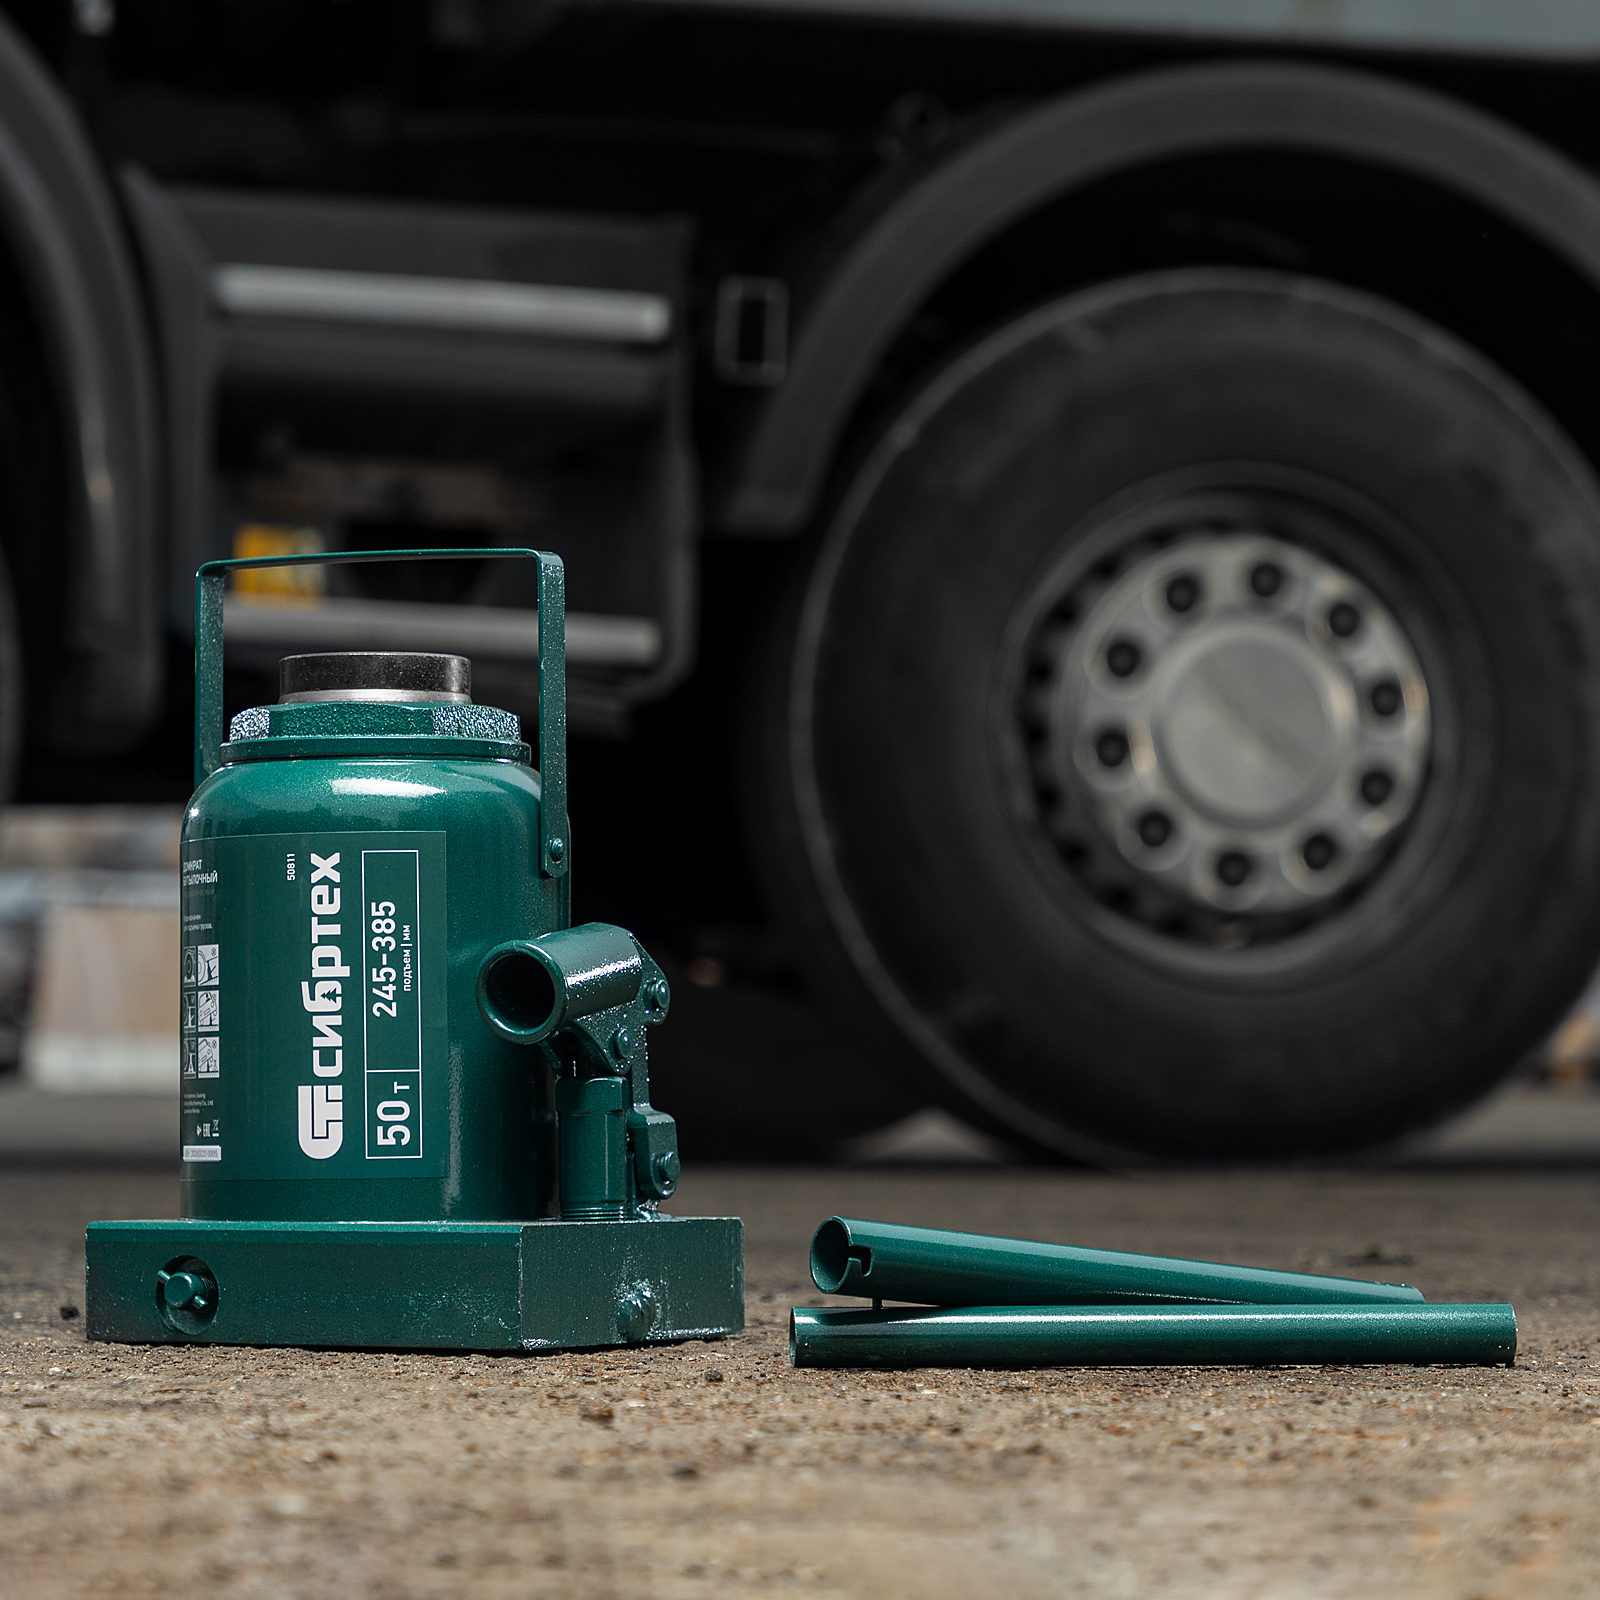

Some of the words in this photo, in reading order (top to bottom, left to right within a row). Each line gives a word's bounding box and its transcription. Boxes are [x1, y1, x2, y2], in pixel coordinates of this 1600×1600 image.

[286, 853, 296, 881] 50811
[402, 924, 411, 941] мм
[371, 901, 397, 1018] 245-385
[403, 949, 413, 992] подъем
[376, 1100, 411, 1146] 50
